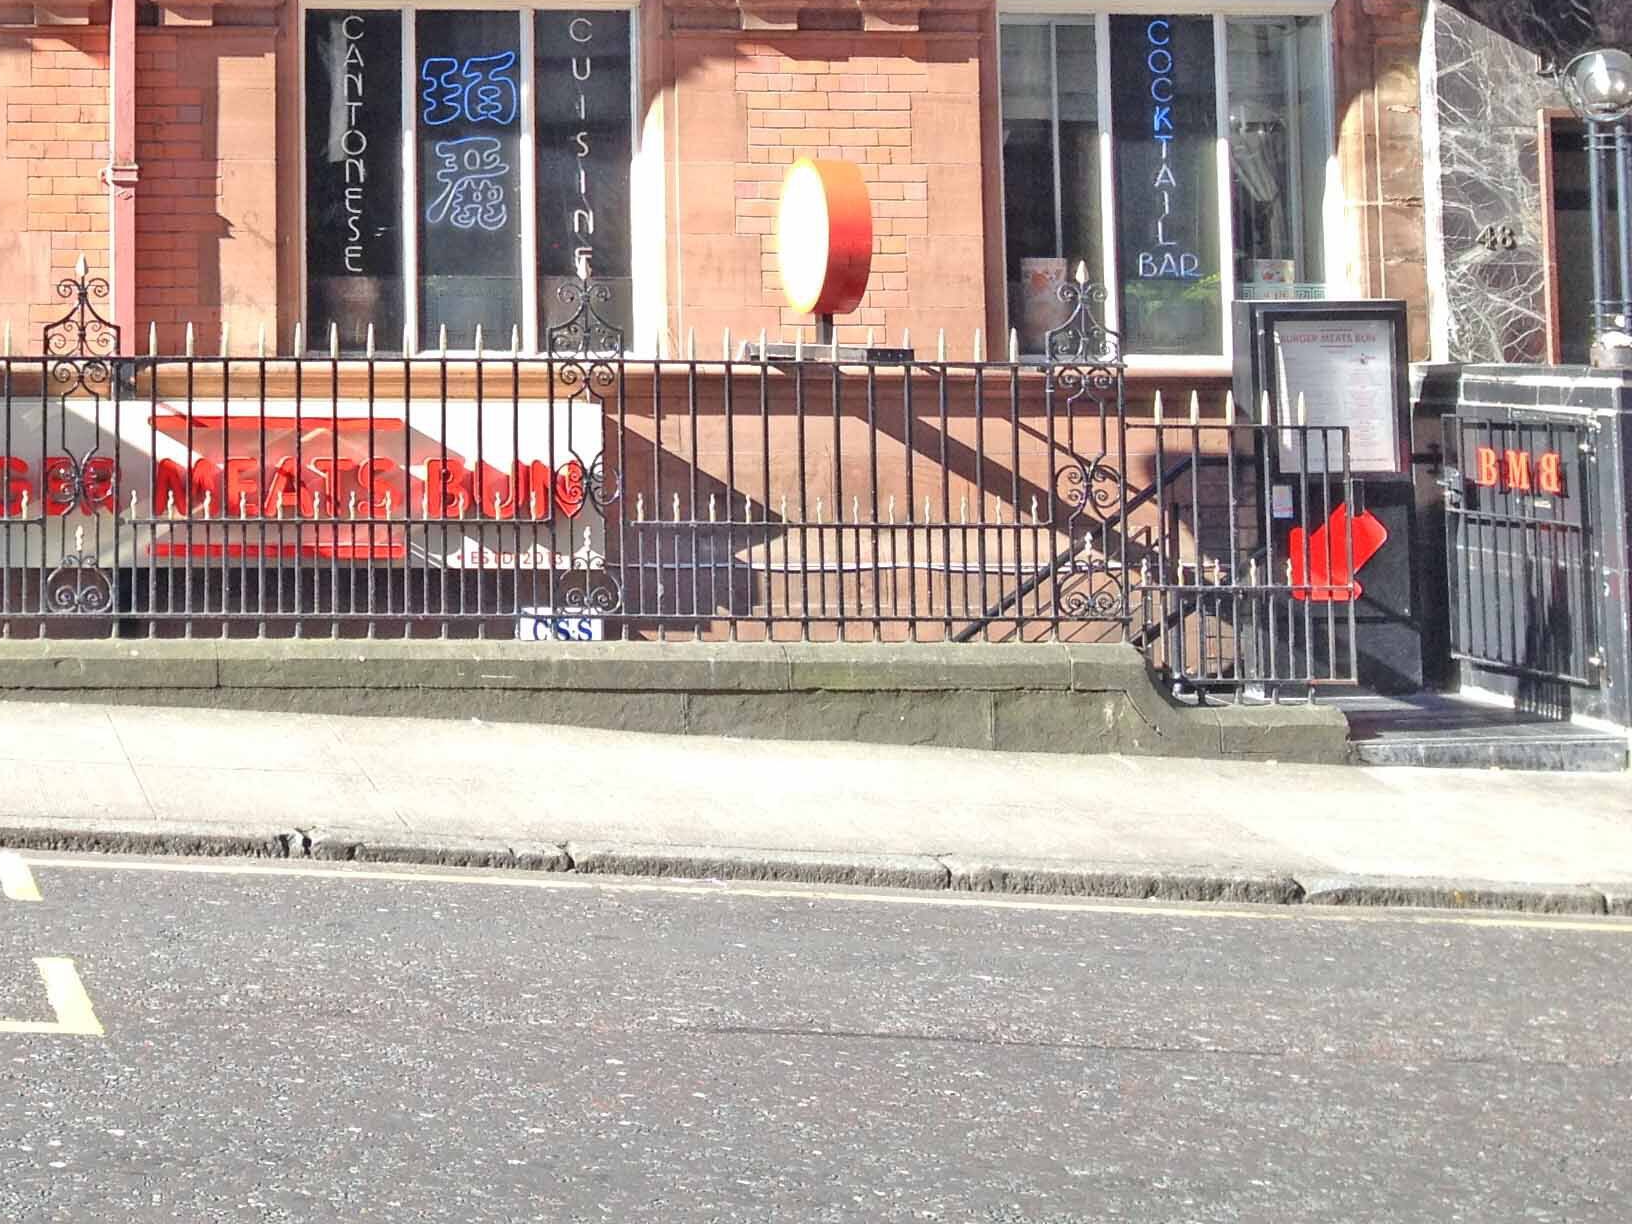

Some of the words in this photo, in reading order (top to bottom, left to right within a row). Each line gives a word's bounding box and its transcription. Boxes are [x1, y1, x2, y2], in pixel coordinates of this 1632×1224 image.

[341, 15, 367, 272] CANTONESE
[1147, 20, 1177, 246] COCKTAIL
[1138, 252, 1204, 277] BAR
[155, 455, 400, 519] MEATS
[423, 455, 585, 519] BUN
